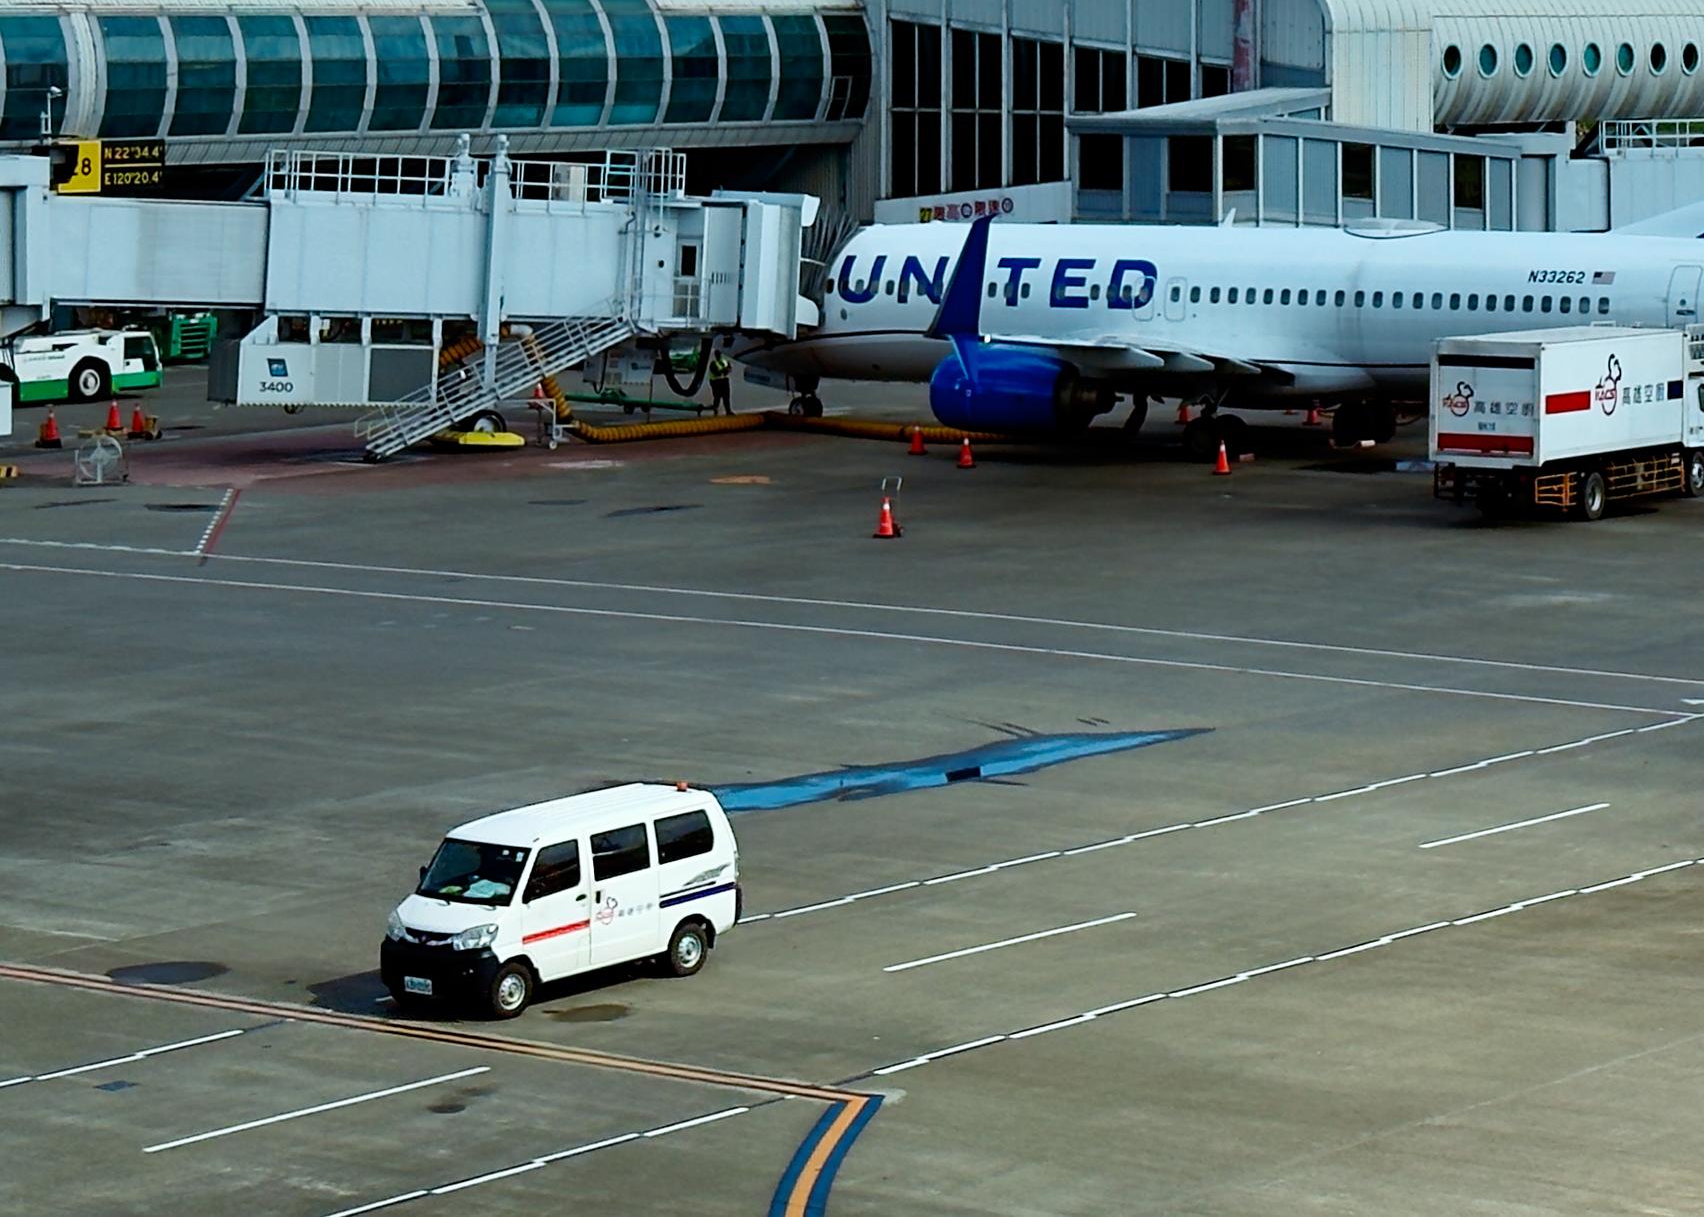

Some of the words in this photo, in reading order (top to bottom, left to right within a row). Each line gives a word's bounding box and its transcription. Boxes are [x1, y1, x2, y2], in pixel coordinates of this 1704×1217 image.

[838, 255, 1157, 309] UNTED
[1528, 270, 1586, 284] N33262
[259, 381, 294, 393] 3400
